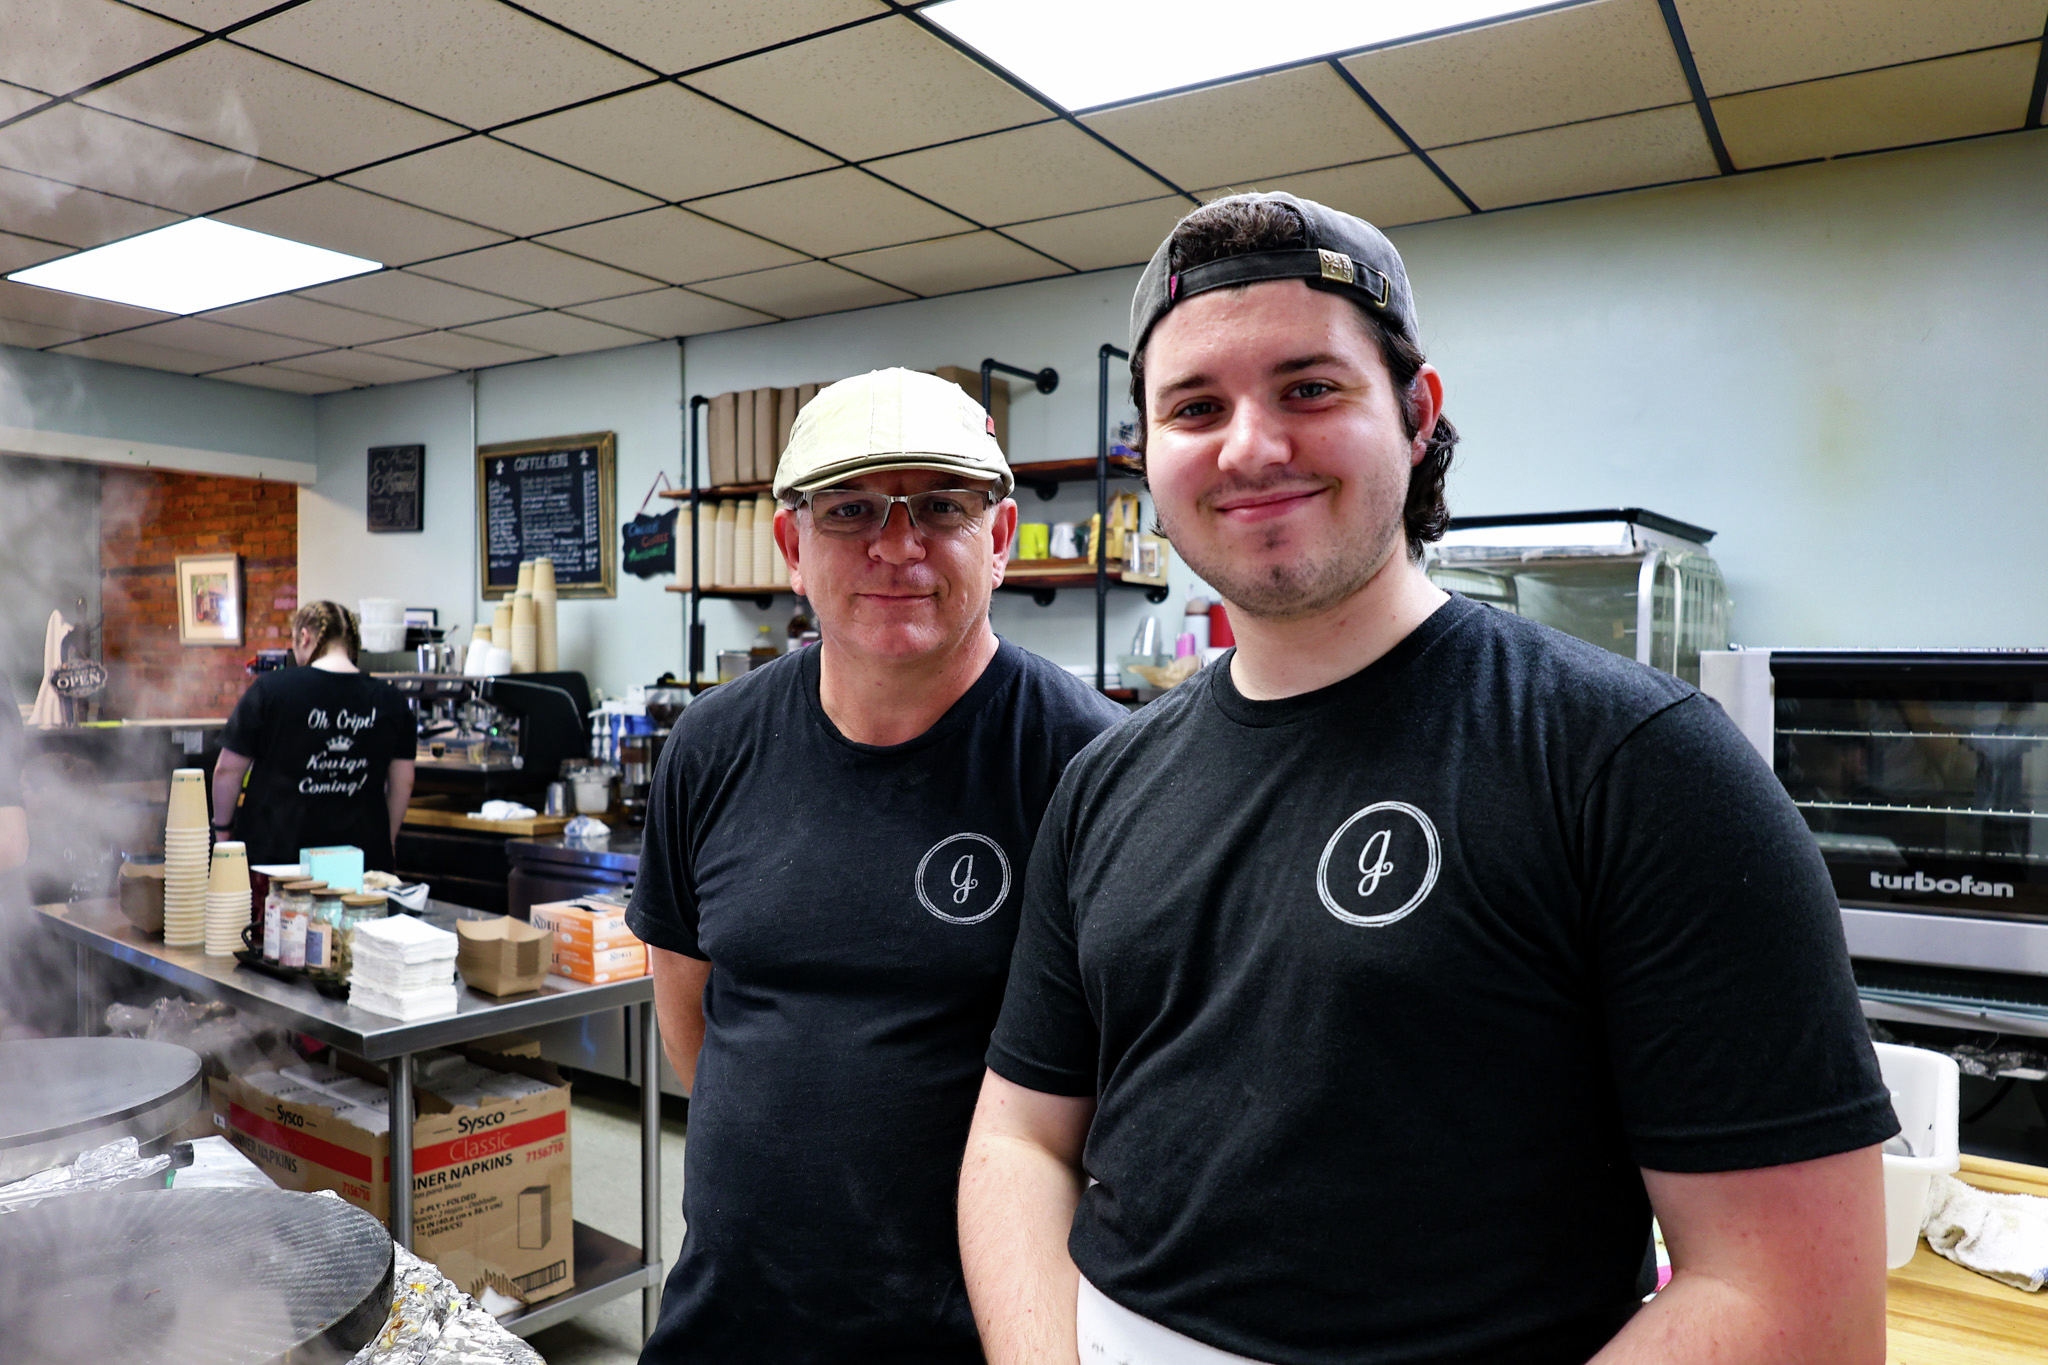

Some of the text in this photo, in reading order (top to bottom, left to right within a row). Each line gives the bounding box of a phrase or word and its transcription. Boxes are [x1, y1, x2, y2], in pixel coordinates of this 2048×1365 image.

[57, 672, 101, 689] OPEN
[307, 707, 330, 730] Oh
[298, 772, 368, 797] Coming!
[1869, 870, 2015, 898] turbofan
[257, 1143, 298, 1173] NAPKINS
[450, 1131, 512, 1162] Classic
[449, 1152, 513, 1182] NAPKINS
[447, 1193, 476, 1205] FOLDED
